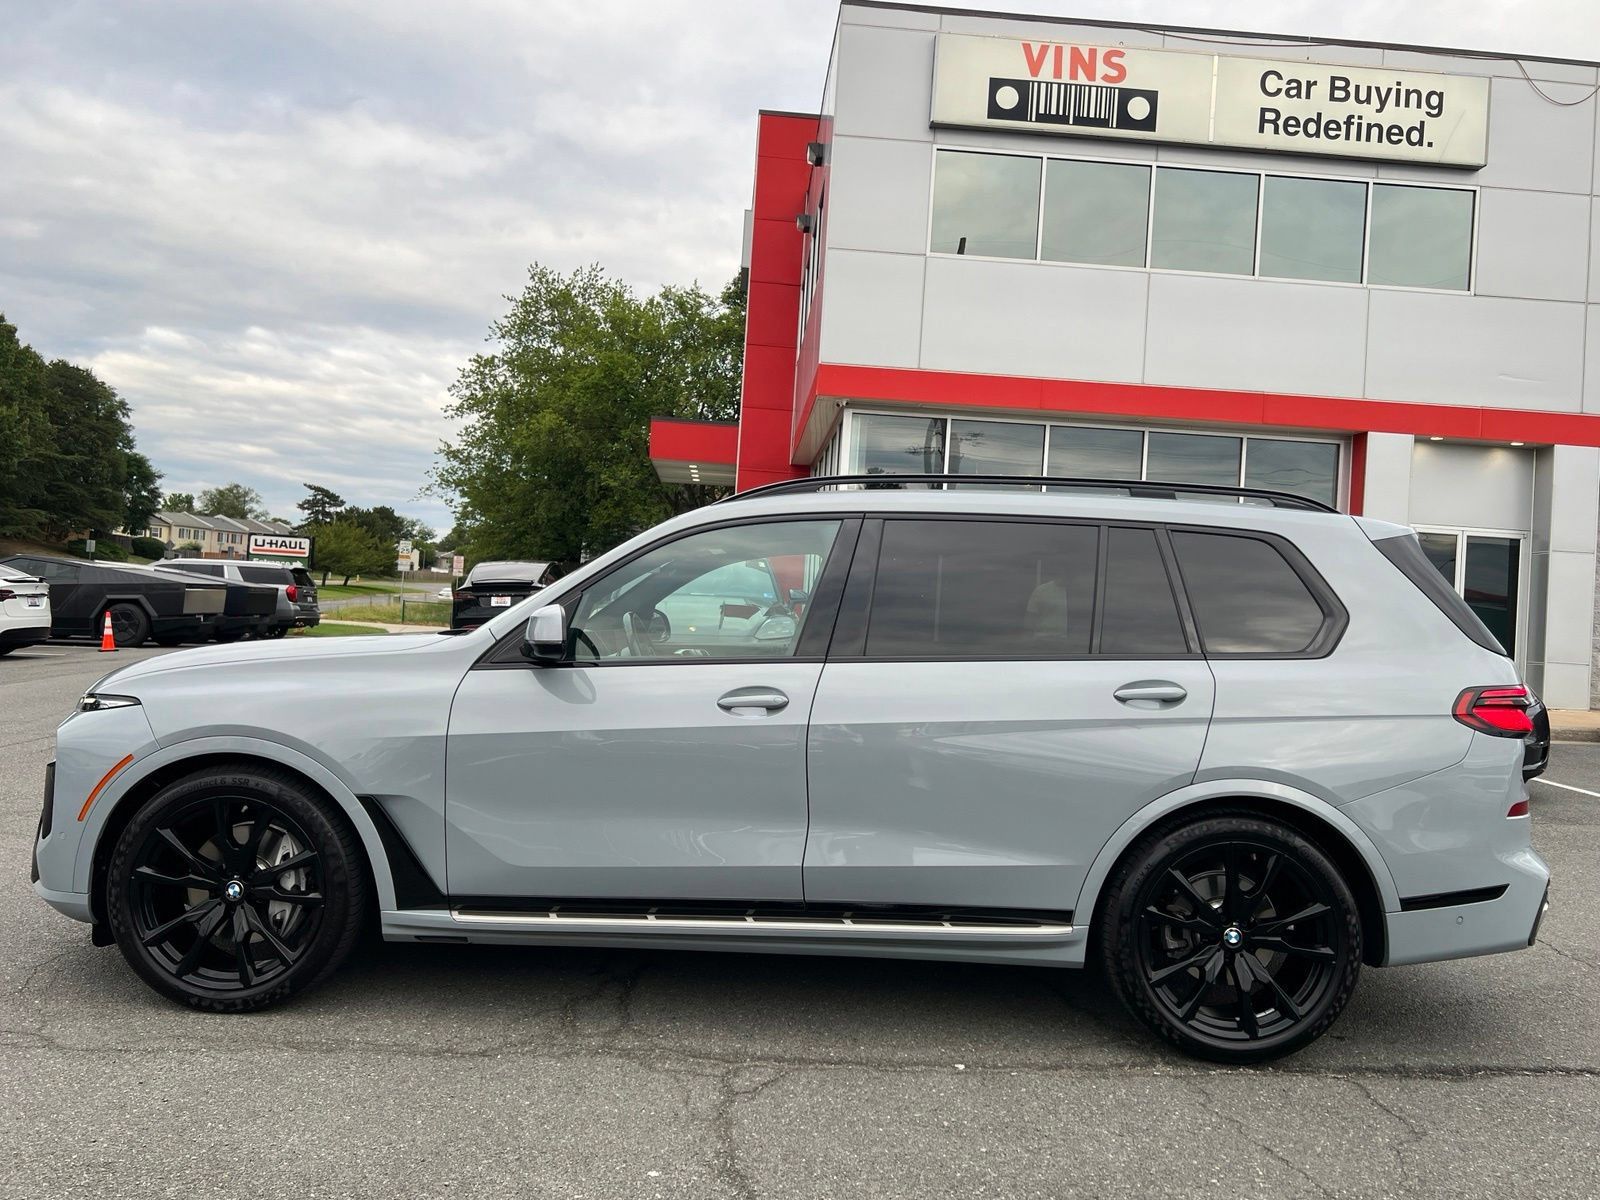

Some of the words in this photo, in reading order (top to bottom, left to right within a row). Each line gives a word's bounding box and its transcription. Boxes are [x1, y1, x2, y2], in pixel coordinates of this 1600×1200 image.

[1021, 42, 1127, 84] VINS
[1260, 70, 1318, 101] Car
[1329, 75, 1445, 118] Buying
[1258, 107, 1434, 148] Redefined.
[254, 538, 306, 550] U-HAUL
